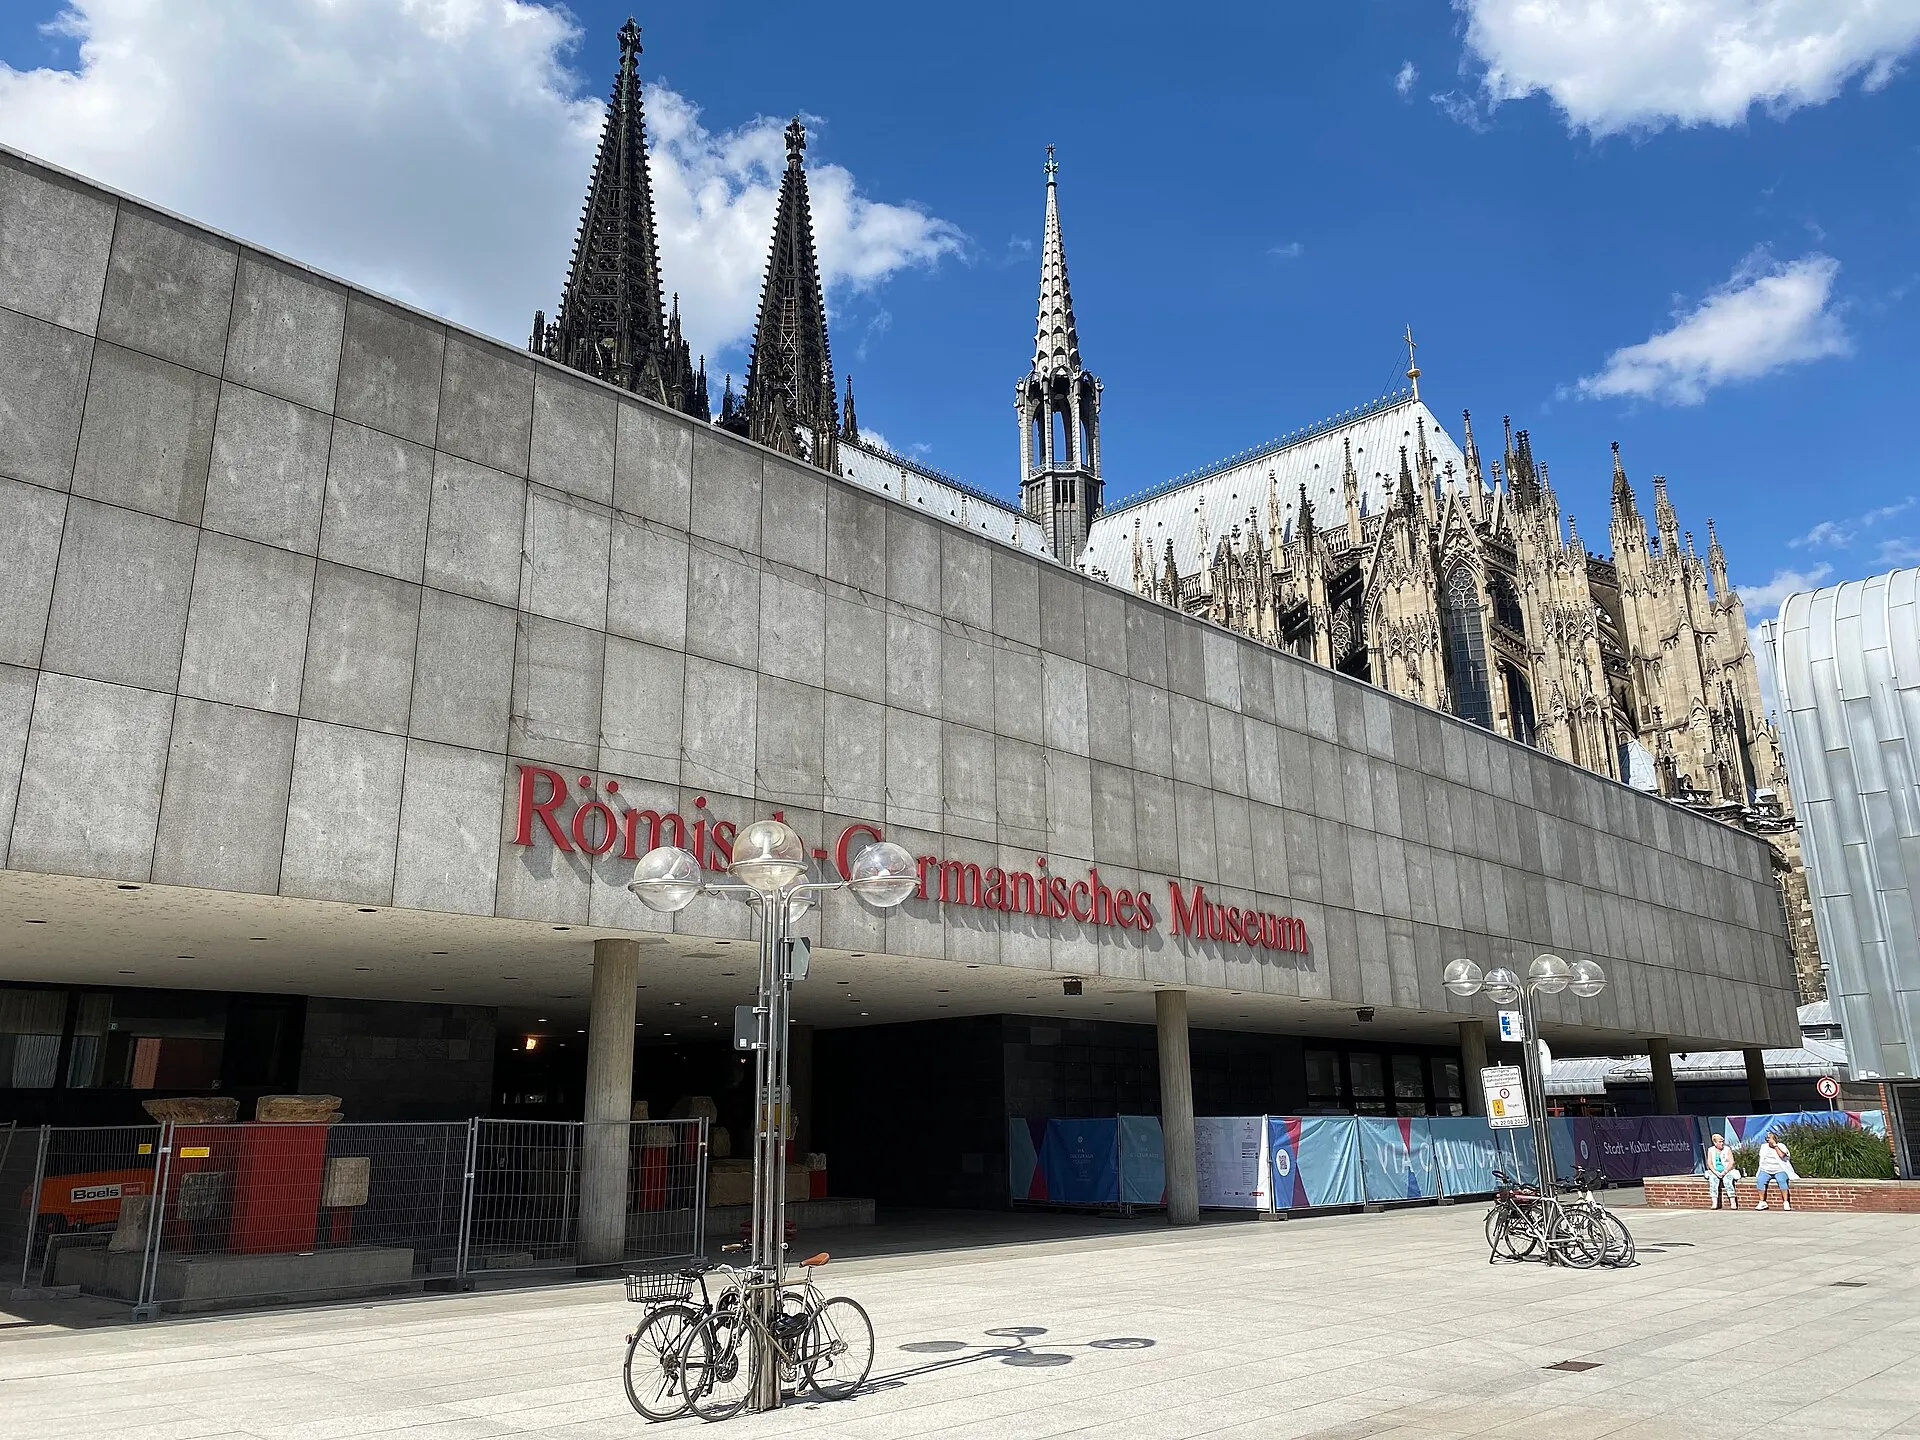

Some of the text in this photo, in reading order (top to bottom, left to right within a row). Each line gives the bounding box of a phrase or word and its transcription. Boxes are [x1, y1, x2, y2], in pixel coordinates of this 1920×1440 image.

[1168, 881, 1309, 955] Museum
[1377, 1142, 1413, 1174] VIA
[1603, 1141, 1625, 1155] Stadt
[1630, 1140, 1651, 1154] Kultur
[1656, 1139, 1691, 1153] Geschichte
[73, 1187, 119, 1200] Boels
